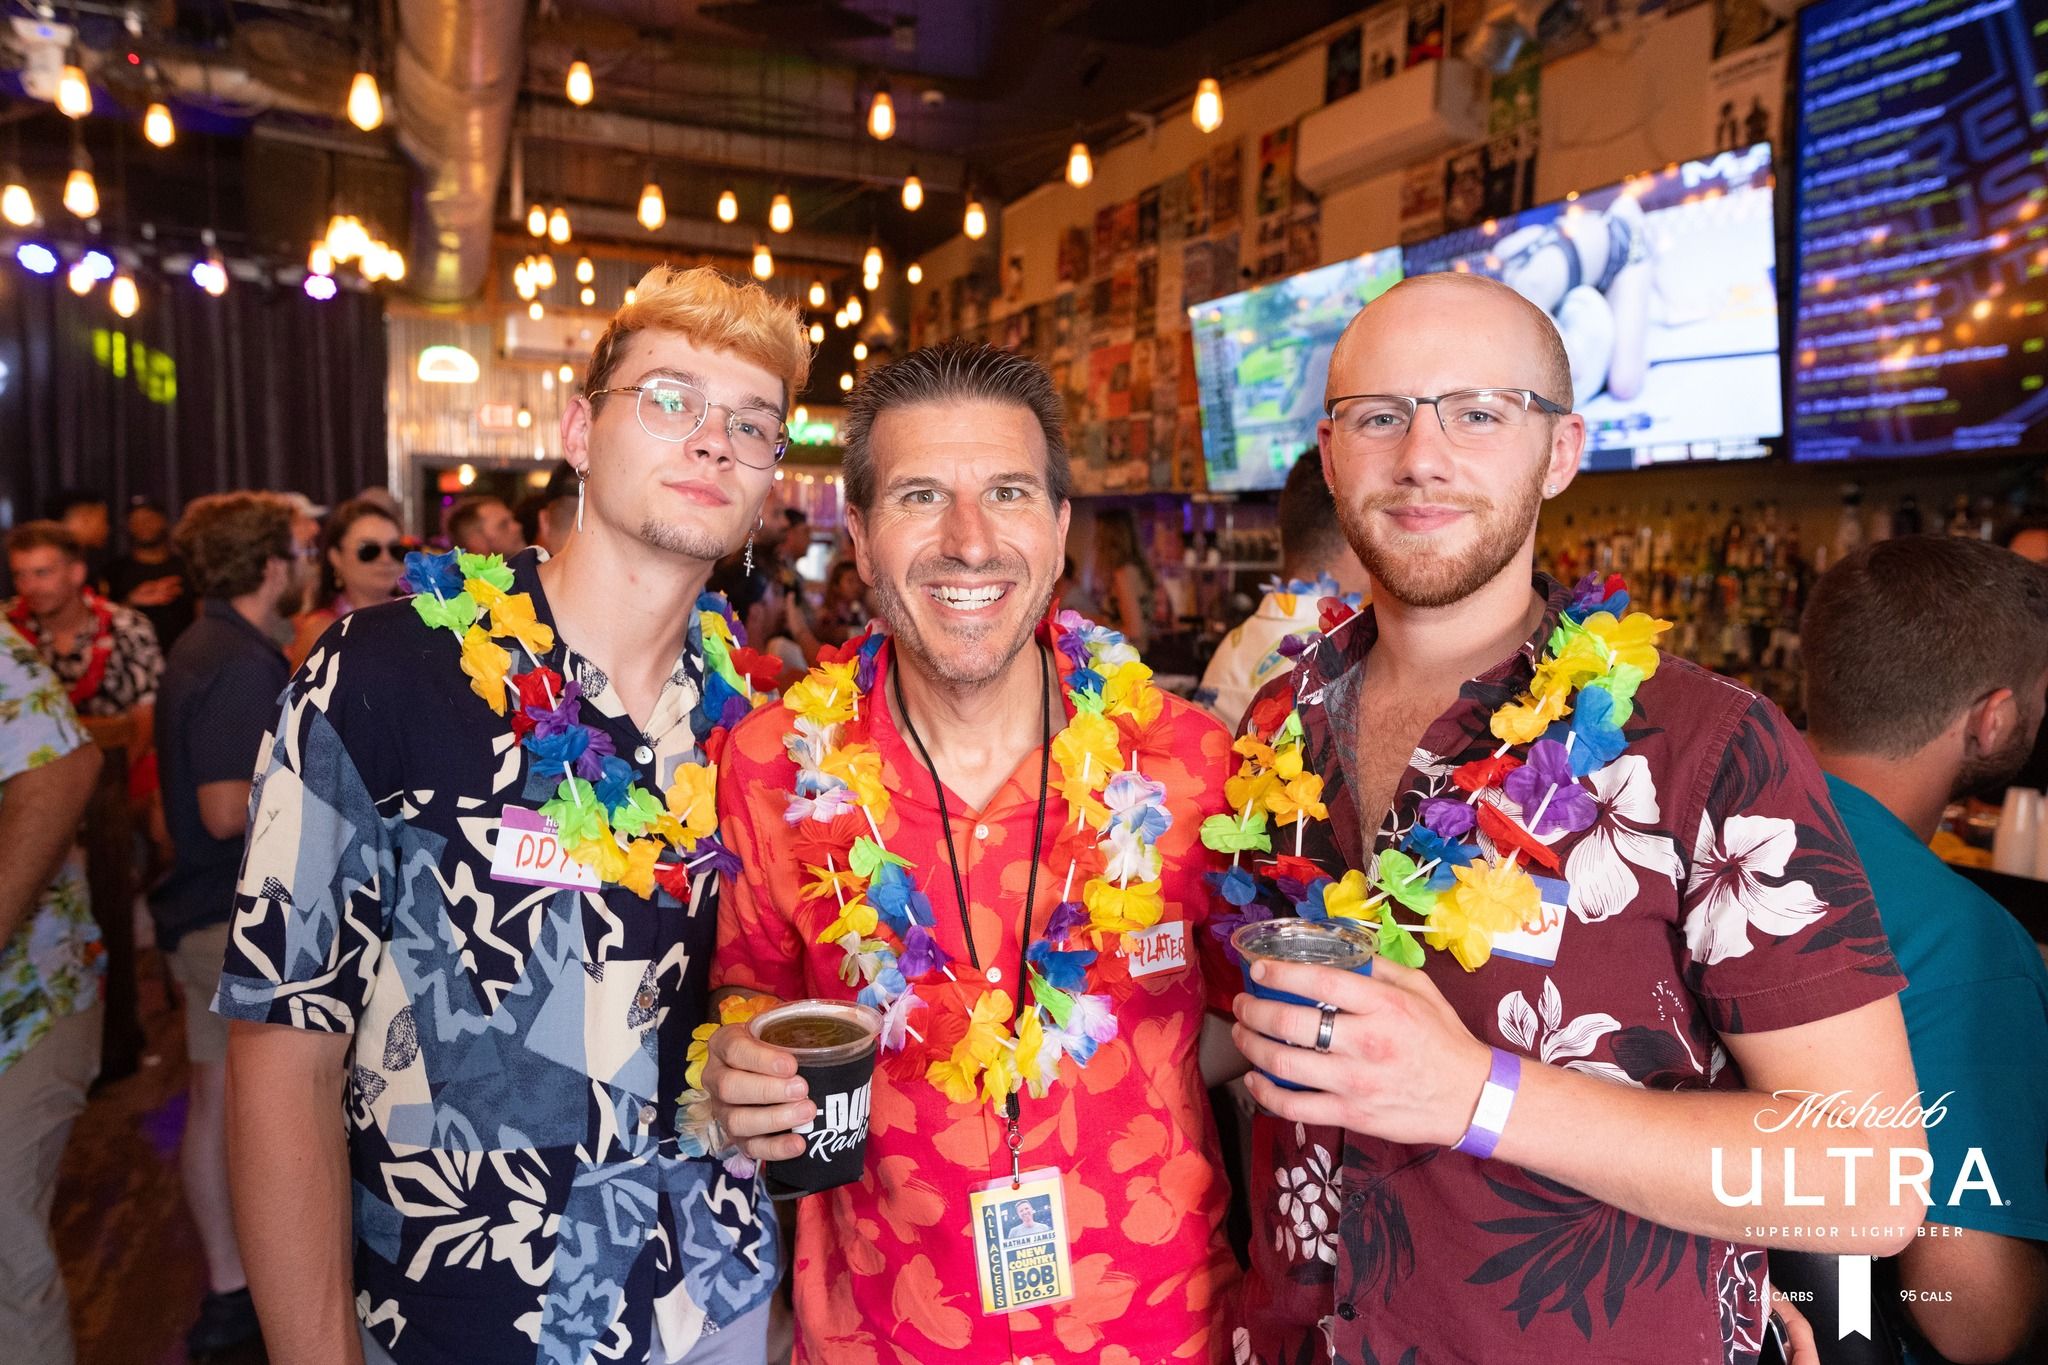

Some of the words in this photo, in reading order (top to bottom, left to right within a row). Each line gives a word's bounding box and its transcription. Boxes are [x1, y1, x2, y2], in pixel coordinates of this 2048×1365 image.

[985, 1207, 996, 1239] ALL
[1003, 1237, 1031, 1249] NATHAN
[1034, 1232, 1056, 1243] JAMES
[1016, 1244, 1047, 1259] NEW
[1008, 1253, 1056, 1270] COUNTRY
[990, 1244, 1005, 1307] ACCESS
[1013, 1265, 1055, 1291] BOB
[1015, 1285, 1055, 1301] 106.9
